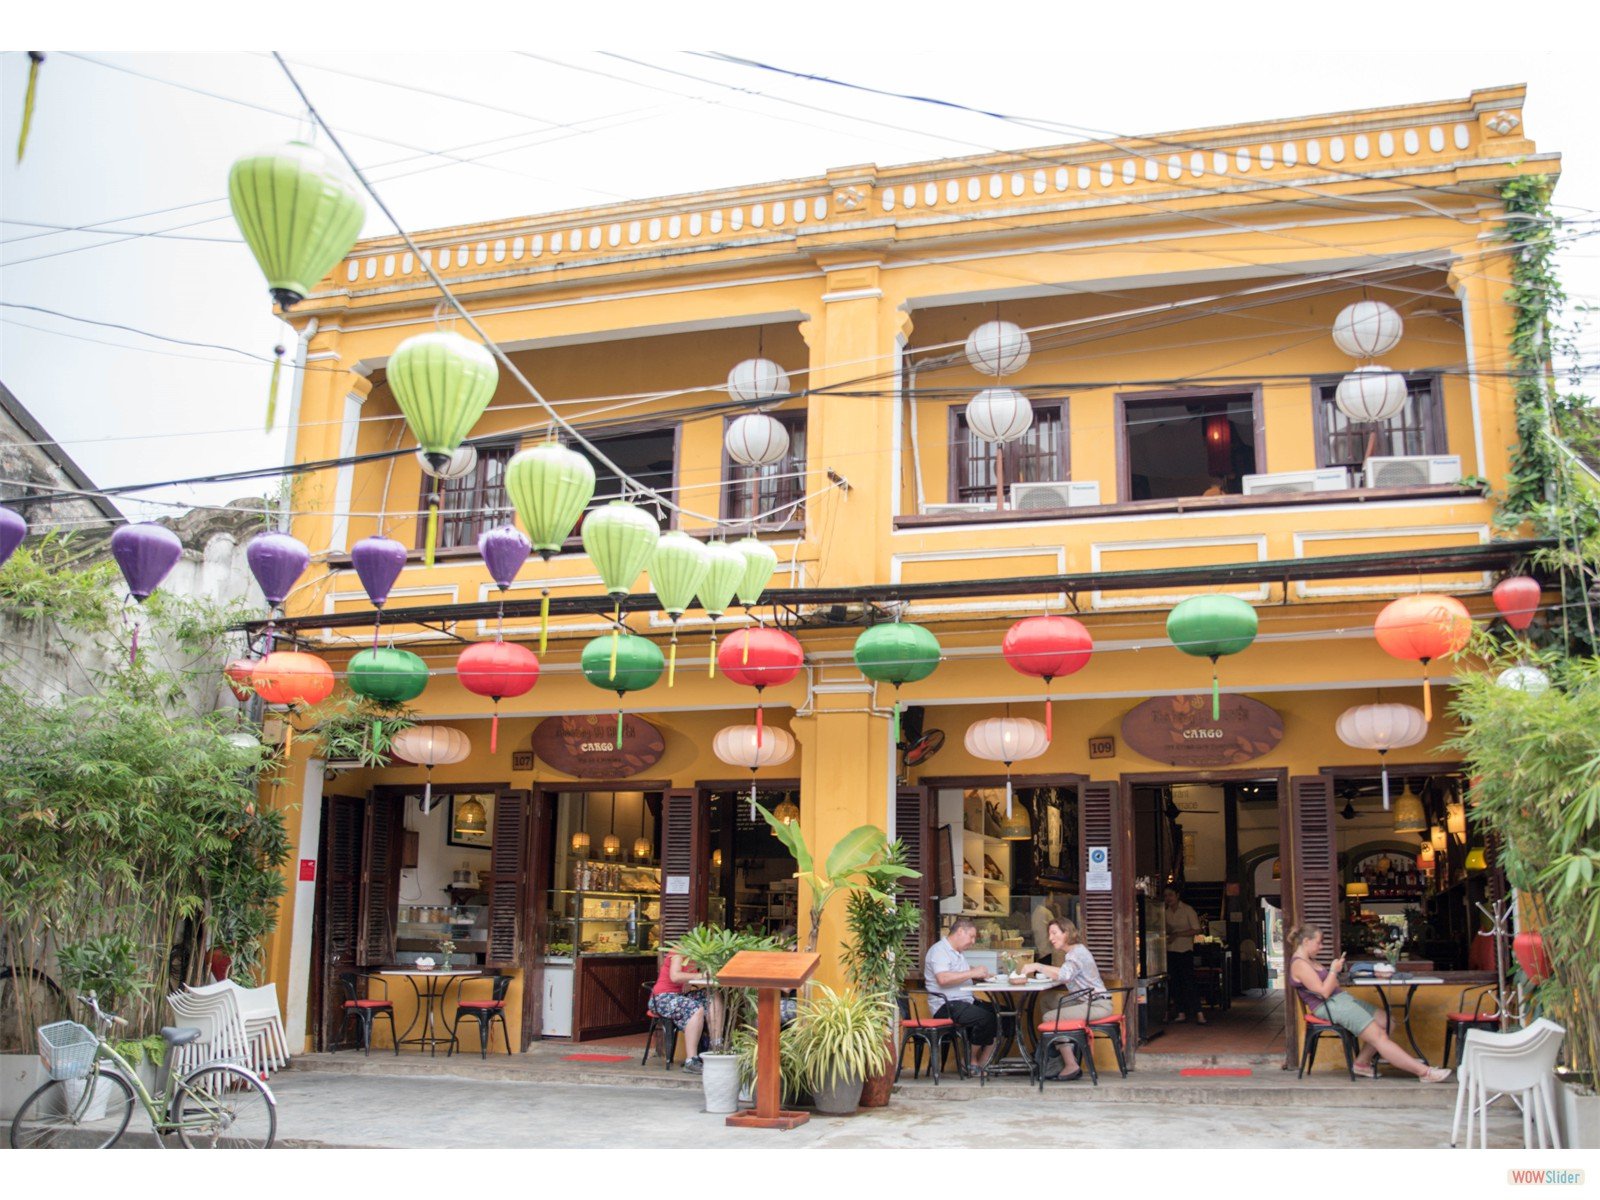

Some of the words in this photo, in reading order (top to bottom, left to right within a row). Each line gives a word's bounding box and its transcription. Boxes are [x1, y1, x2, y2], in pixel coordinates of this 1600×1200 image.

[1183, 729, 1224, 739] CARGO
[581, 742, 614, 752] CARGO
[1092, 743, 1112, 753] 109
[515, 756, 531, 766] 107
